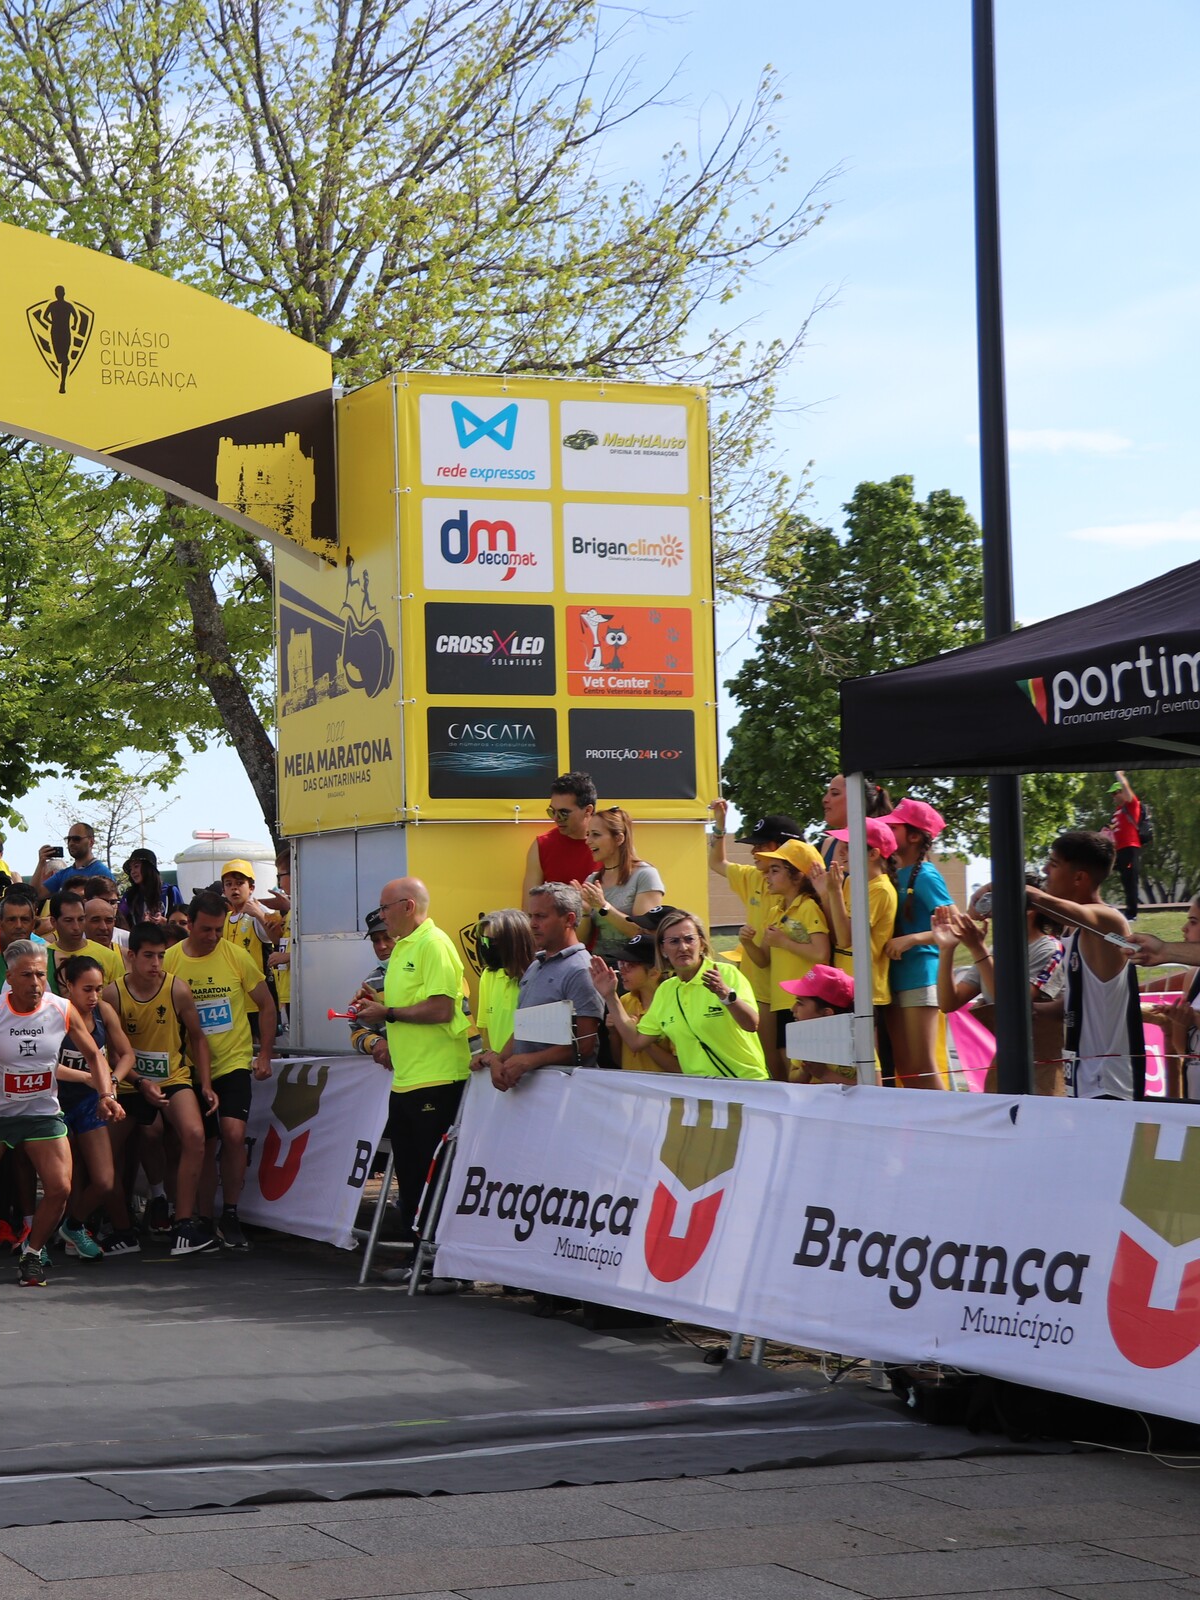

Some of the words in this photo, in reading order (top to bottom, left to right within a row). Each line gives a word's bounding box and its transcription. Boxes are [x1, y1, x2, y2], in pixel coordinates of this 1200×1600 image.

[99, 327, 170, 349] GINÁSIO
[100, 350, 159, 367] CLUBE
[101, 369, 198, 392] BRAGANÇA
[602, 433, 686, 449] MadridAuto
[437, 463, 467, 478] rede
[470, 468, 536, 482] expressos
[572, 537, 674, 558] Briganclima
[478, 550, 538, 566] decomat
[582, 676, 605, 688] Vet
[607, 677, 651, 688] Center
[1062, 705, 1151, 725] cronometragem
[448, 723, 536, 740] CASCATA
[284, 752, 315, 778] MEIA
[317, 737, 392, 772] MARATONA
[585, 748, 658, 761] PROTEÇÃO24H
[303, 779, 317, 792] DAS
[318, 769, 371, 790] CANTARINHAS
[9, 1026, 44, 1038] Portugal
[132, 1058, 166, 1074] 034
[456, 1166, 639, 1242] Bragança
[553, 1236, 623, 1270] Município
[792, 1205, 1091, 1310] Bragança
[960, 1305, 1075, 1349] Município
